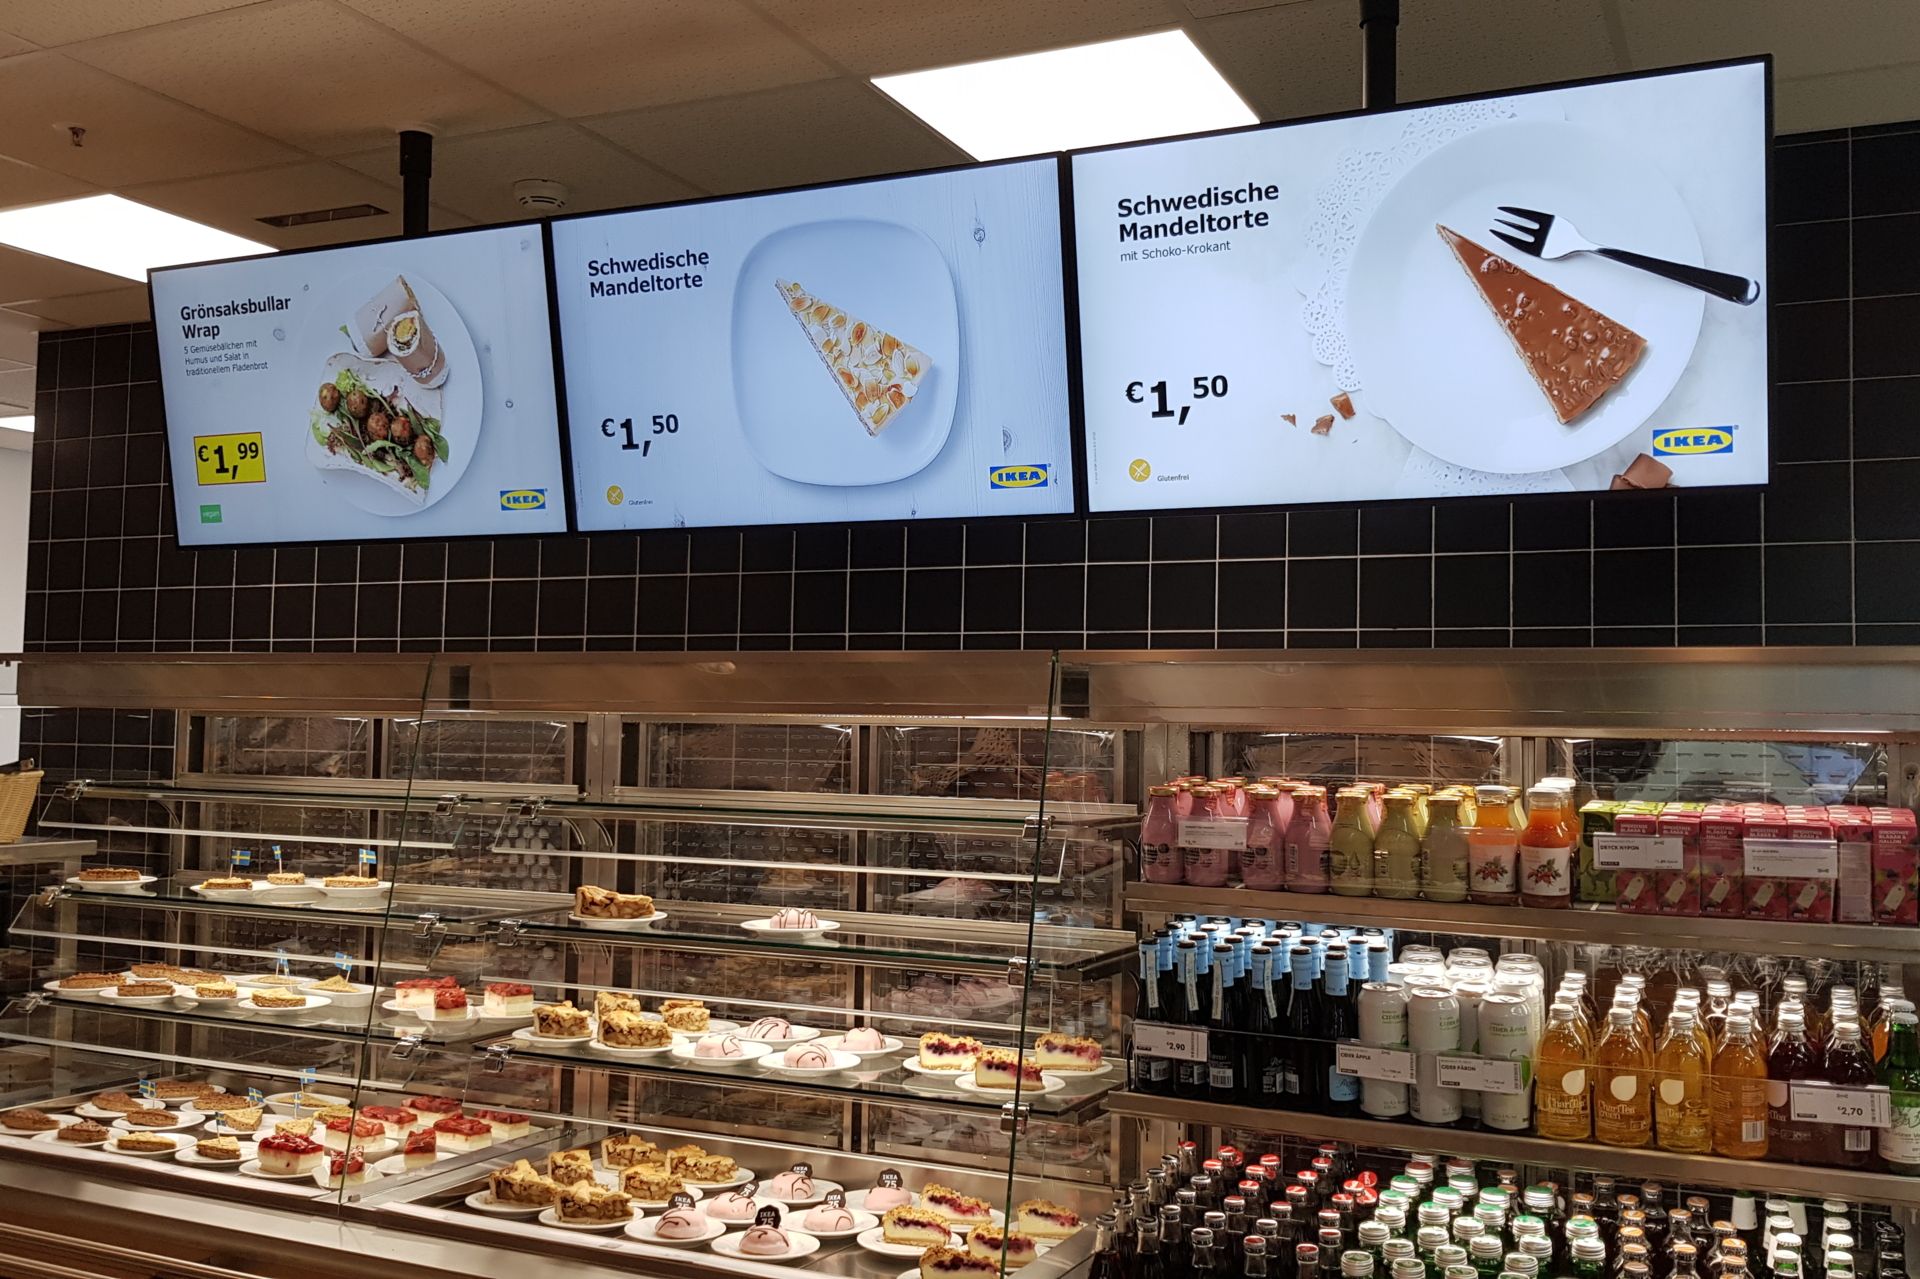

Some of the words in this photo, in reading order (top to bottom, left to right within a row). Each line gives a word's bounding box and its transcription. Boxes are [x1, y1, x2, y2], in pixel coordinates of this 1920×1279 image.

[1118, 182, 1279, 218] Schwedische
[1119, 209, 1269, 242] Mandeltorte
[1120, 250, 1138, 262] mit
[1142, 240, 1231, 260] Schoko-Krokant
[588, 249, 709, 277] Schwedische
[590, 272, 703, 298] Mandeltorte
[180, 296, 291, 321] Grönsaksbullar
[182, 324, 220, 340] Wrap
[184, 346, 189, 354] 5
[246, 340, 258, 348] mit
[185, 356, 208, 366] Humus
[209, 354, 222, 363] und
[224, 353, 241, 361] Salat
[243, 352, 249, 360] in
[186, 365, 231, 376] traditionellem
[232, 361, 269, 373] Fladenbrot
[1664, 434, 1724, 448] IKEA
[998, 471, 1041, 482] IKEA
[1157, 474, 1190, 482] Glutenfrei
[506, 495, 541, 504] IKEA
[1837, 1106, 1863, 1116] €2,70
[884, 1180, 897, 1188] 75
[674, 1196, 691, 1204] IKEA
[761, 1218, 774, 1227] 75
